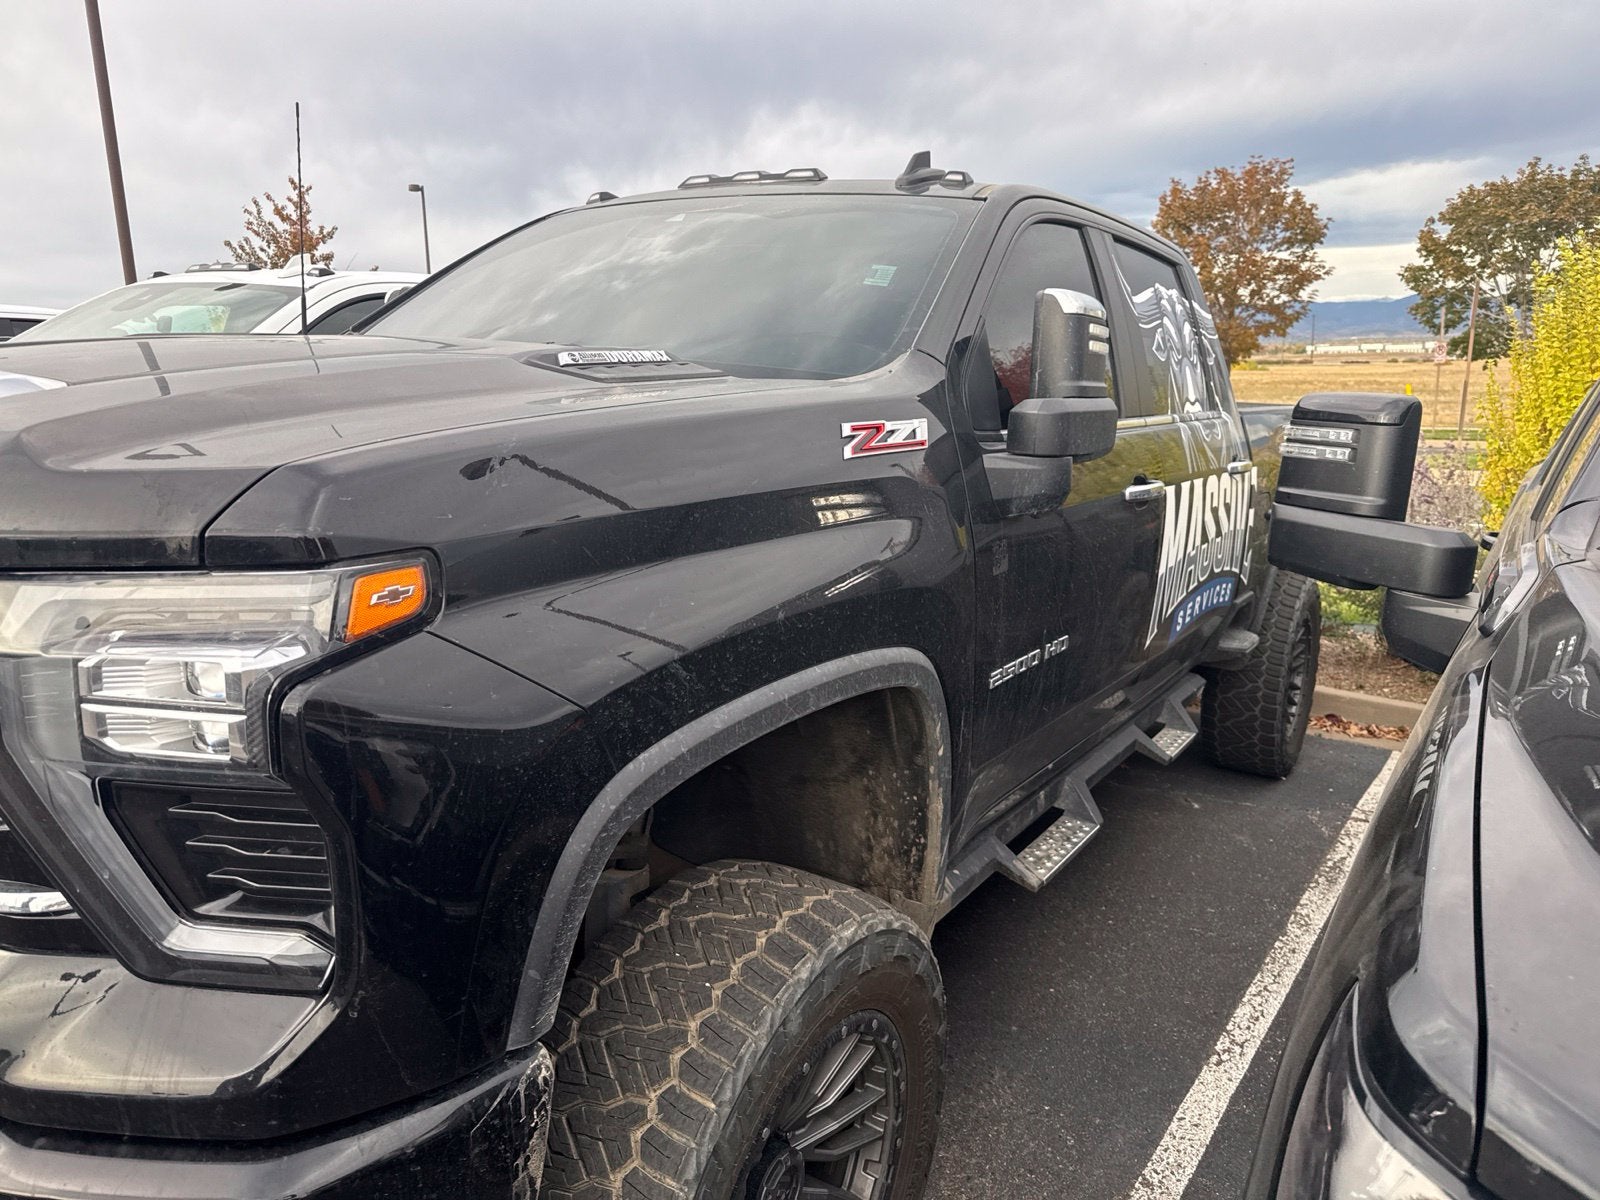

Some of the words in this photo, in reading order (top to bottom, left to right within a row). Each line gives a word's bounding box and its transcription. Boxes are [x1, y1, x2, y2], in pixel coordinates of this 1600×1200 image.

[606, 350, 672, 362] DURAMAX
[841, 418, 928, 460] Z71
[1144, 466, 1258, 650] MASSIVE
[1176, 582, 1232, 632] SERVICES
[989, 649, 1041, 689] 2500
[1044, 635, 1069, 659] HD
